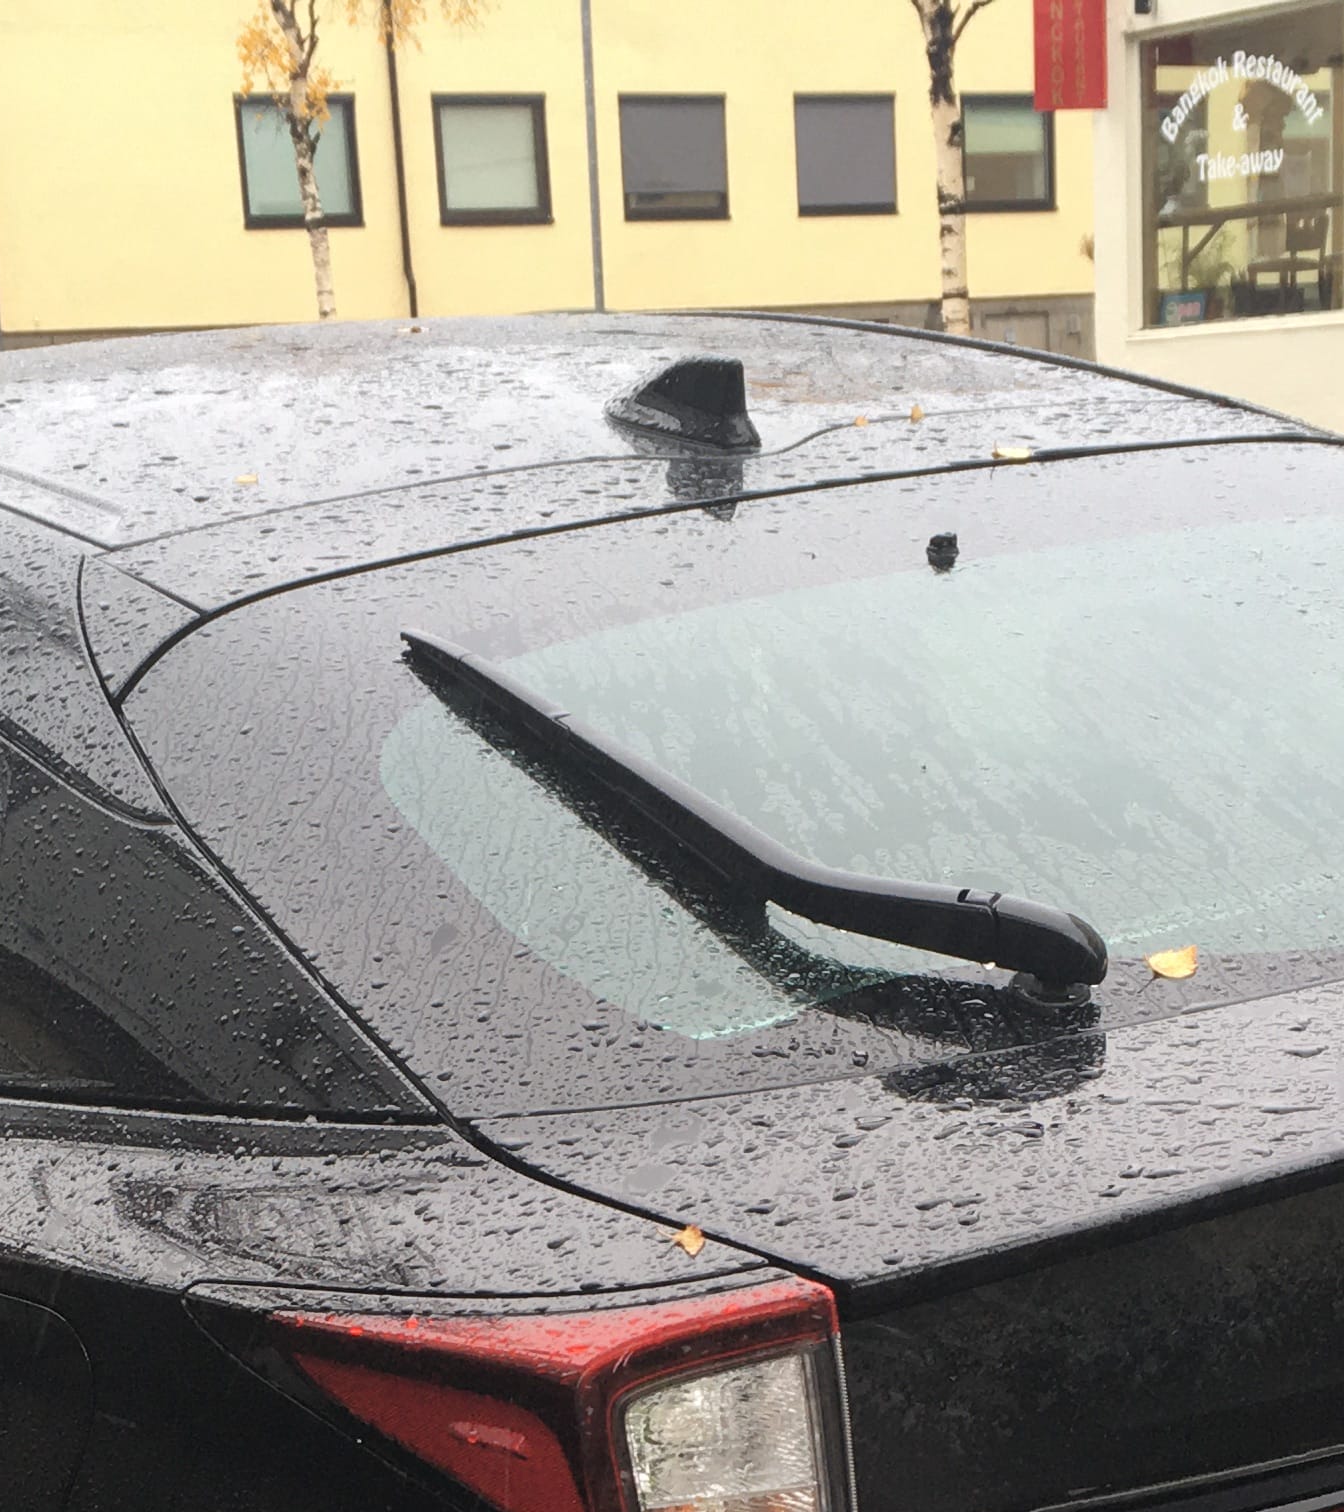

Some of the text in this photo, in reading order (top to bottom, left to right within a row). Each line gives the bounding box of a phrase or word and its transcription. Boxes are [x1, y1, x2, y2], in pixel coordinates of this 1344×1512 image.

[1161, 50, 1324, 144] Bangkok Restaurant
[1232, 103, 1249, 131] &
[1196, 148, 1284, 181] Take-away
